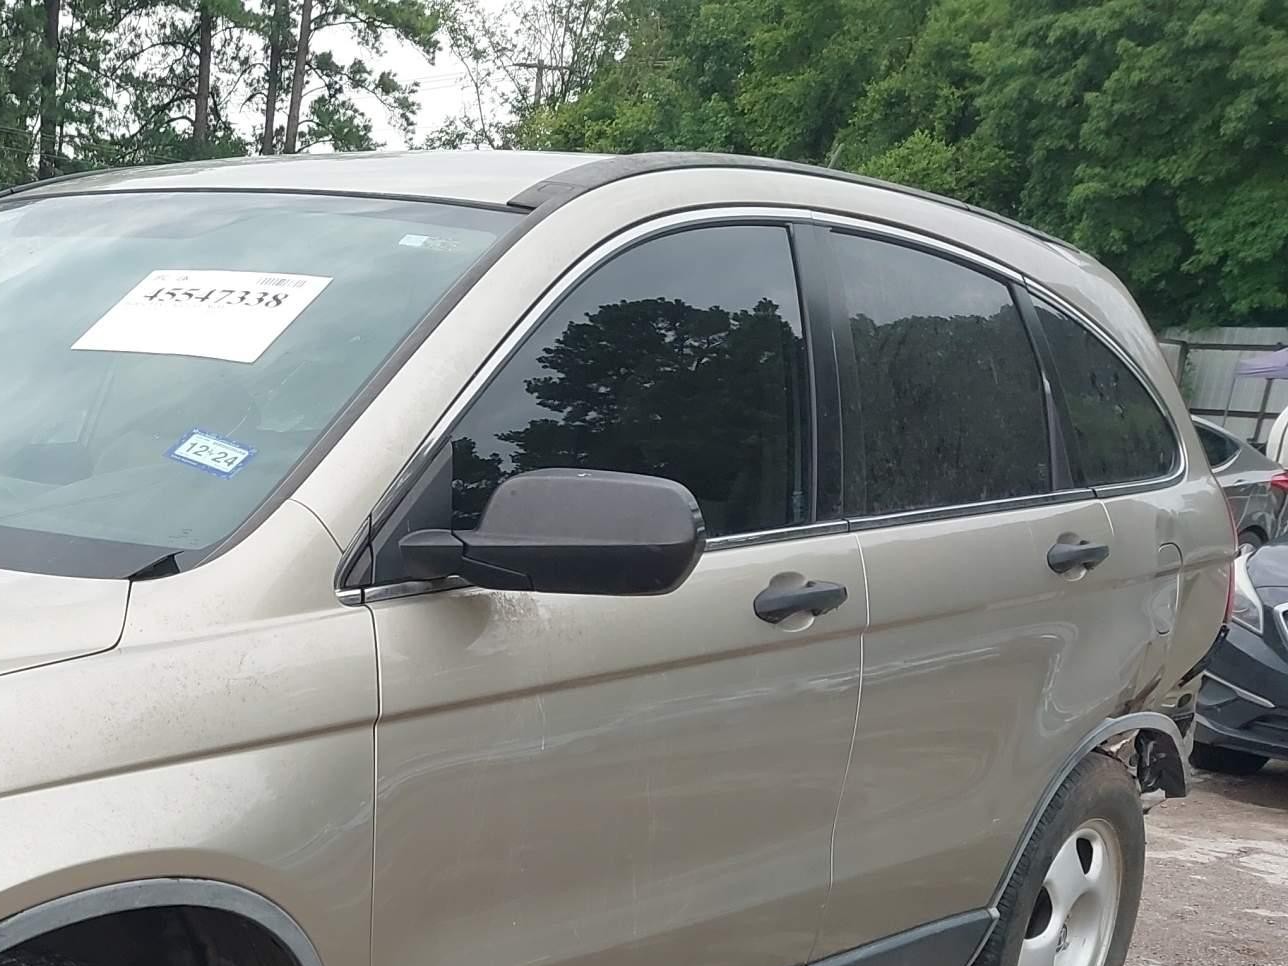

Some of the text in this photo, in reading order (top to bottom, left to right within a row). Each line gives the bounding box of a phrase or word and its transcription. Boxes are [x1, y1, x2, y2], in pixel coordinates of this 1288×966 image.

[142, 287, 289, 308] 45547338
[185, 442, 210, 457] 12
[211, 451, 239, 467] 24
